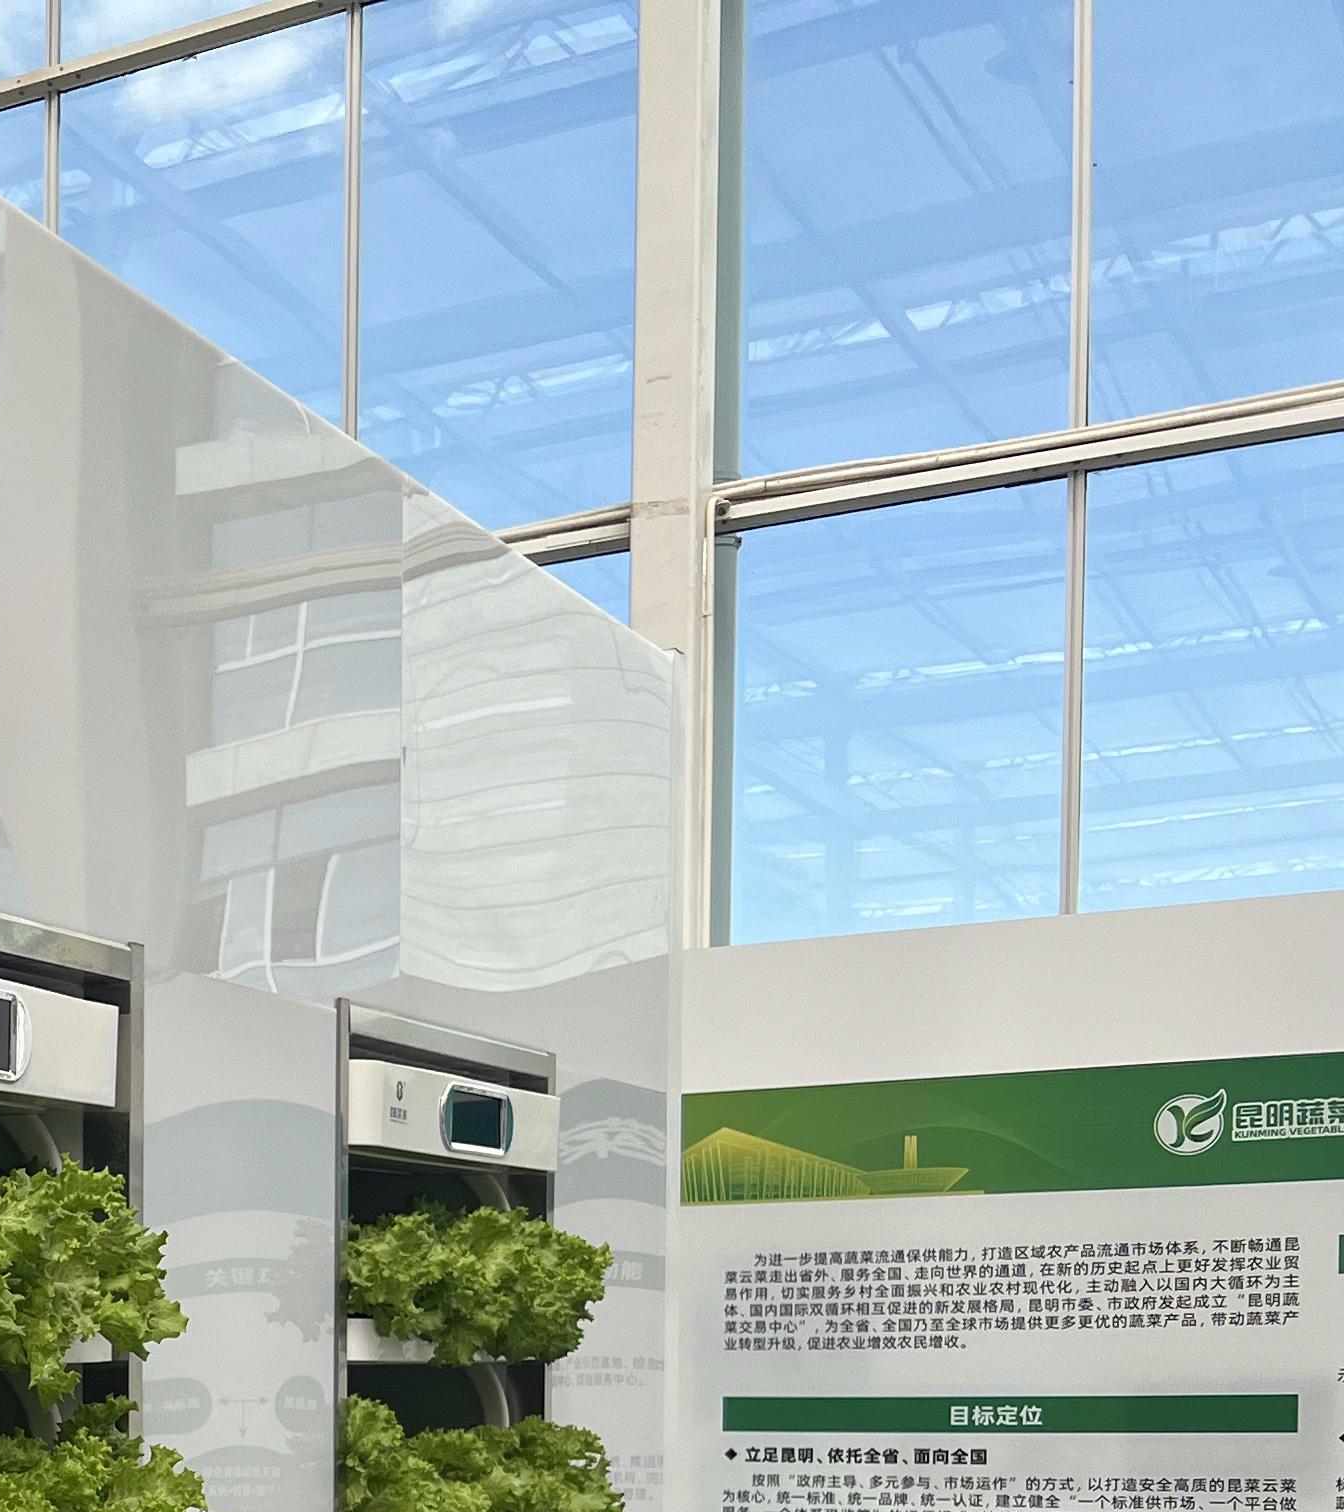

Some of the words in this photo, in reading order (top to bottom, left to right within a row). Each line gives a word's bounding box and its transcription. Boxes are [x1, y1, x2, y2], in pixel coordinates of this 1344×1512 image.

[1234, 1129, 1287, 1140] KUNMING
[948, 1405, 1044, 1428] 目标定位
[744, 1446, 988, 1466] 立足昆明、依托全省、面向全国
